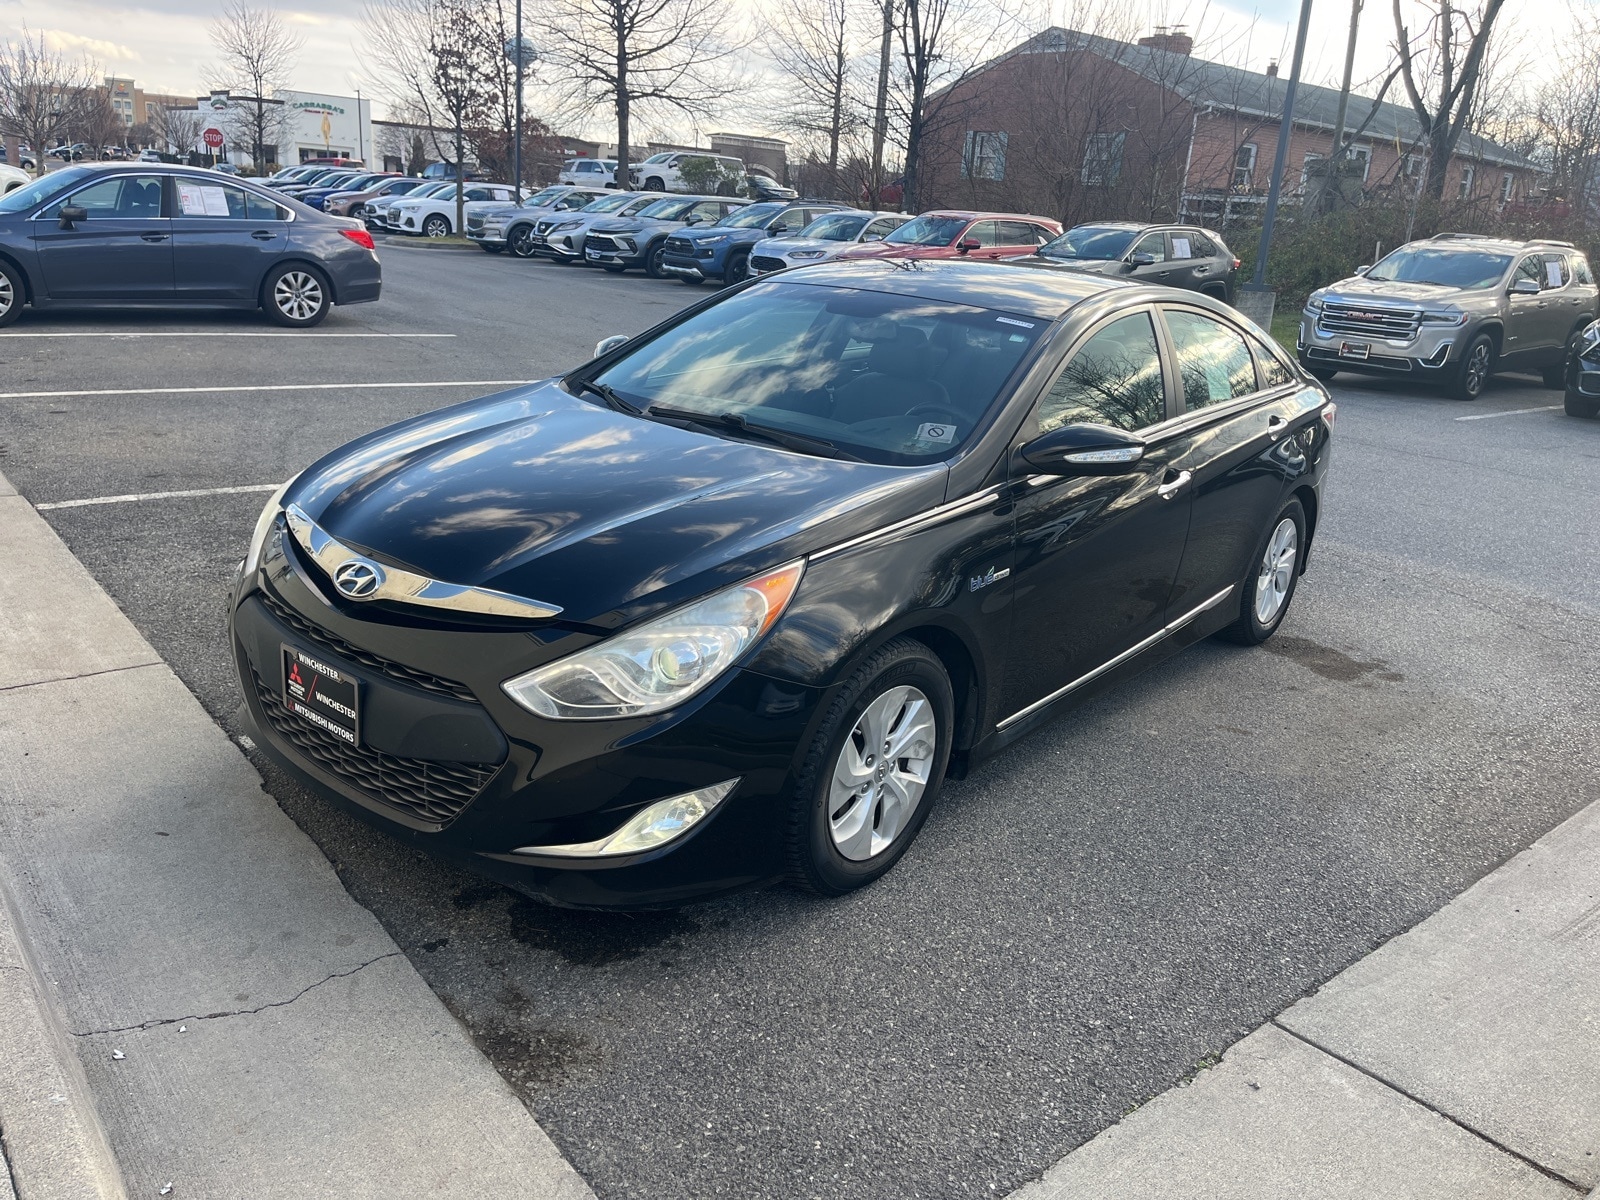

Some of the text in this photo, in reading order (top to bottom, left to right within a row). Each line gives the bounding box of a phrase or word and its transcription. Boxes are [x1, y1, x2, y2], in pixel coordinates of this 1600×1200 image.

[292, 102, 345, 114] CARRABBA'S
[204, 133, 222, 143] STOP
[298, 652, 339, 680] WINCHESTER
[315, 690, 356, 719] WINCHESTER
[294, 702, 354, 743] MITSUBISHI MOTORS
